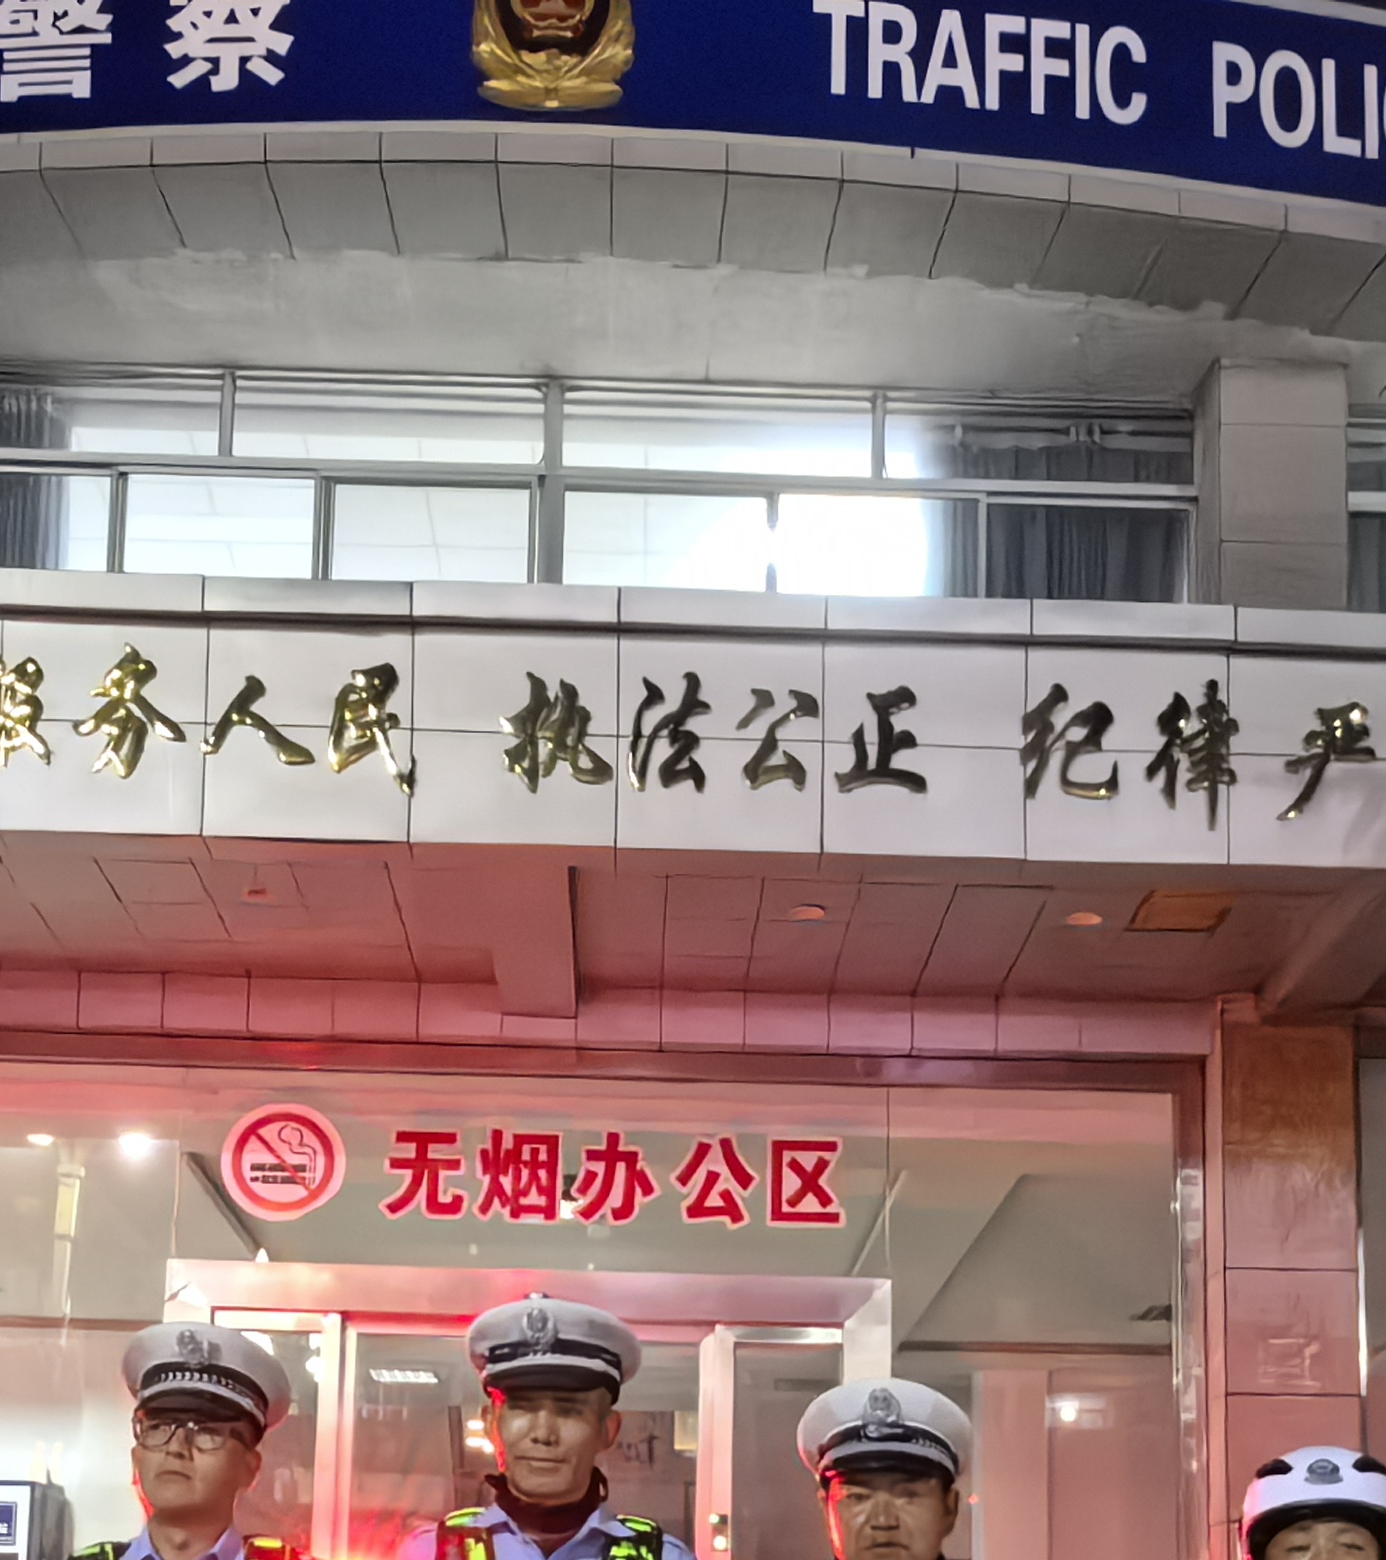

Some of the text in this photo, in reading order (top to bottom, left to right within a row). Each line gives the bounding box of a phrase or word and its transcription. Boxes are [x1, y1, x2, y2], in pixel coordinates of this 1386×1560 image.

[812, 0, 1147, 125] TRAFFIC
[499, 670, 928, 795] 执法公正
[380, 1128, 846, 1230] 无烟办公区
